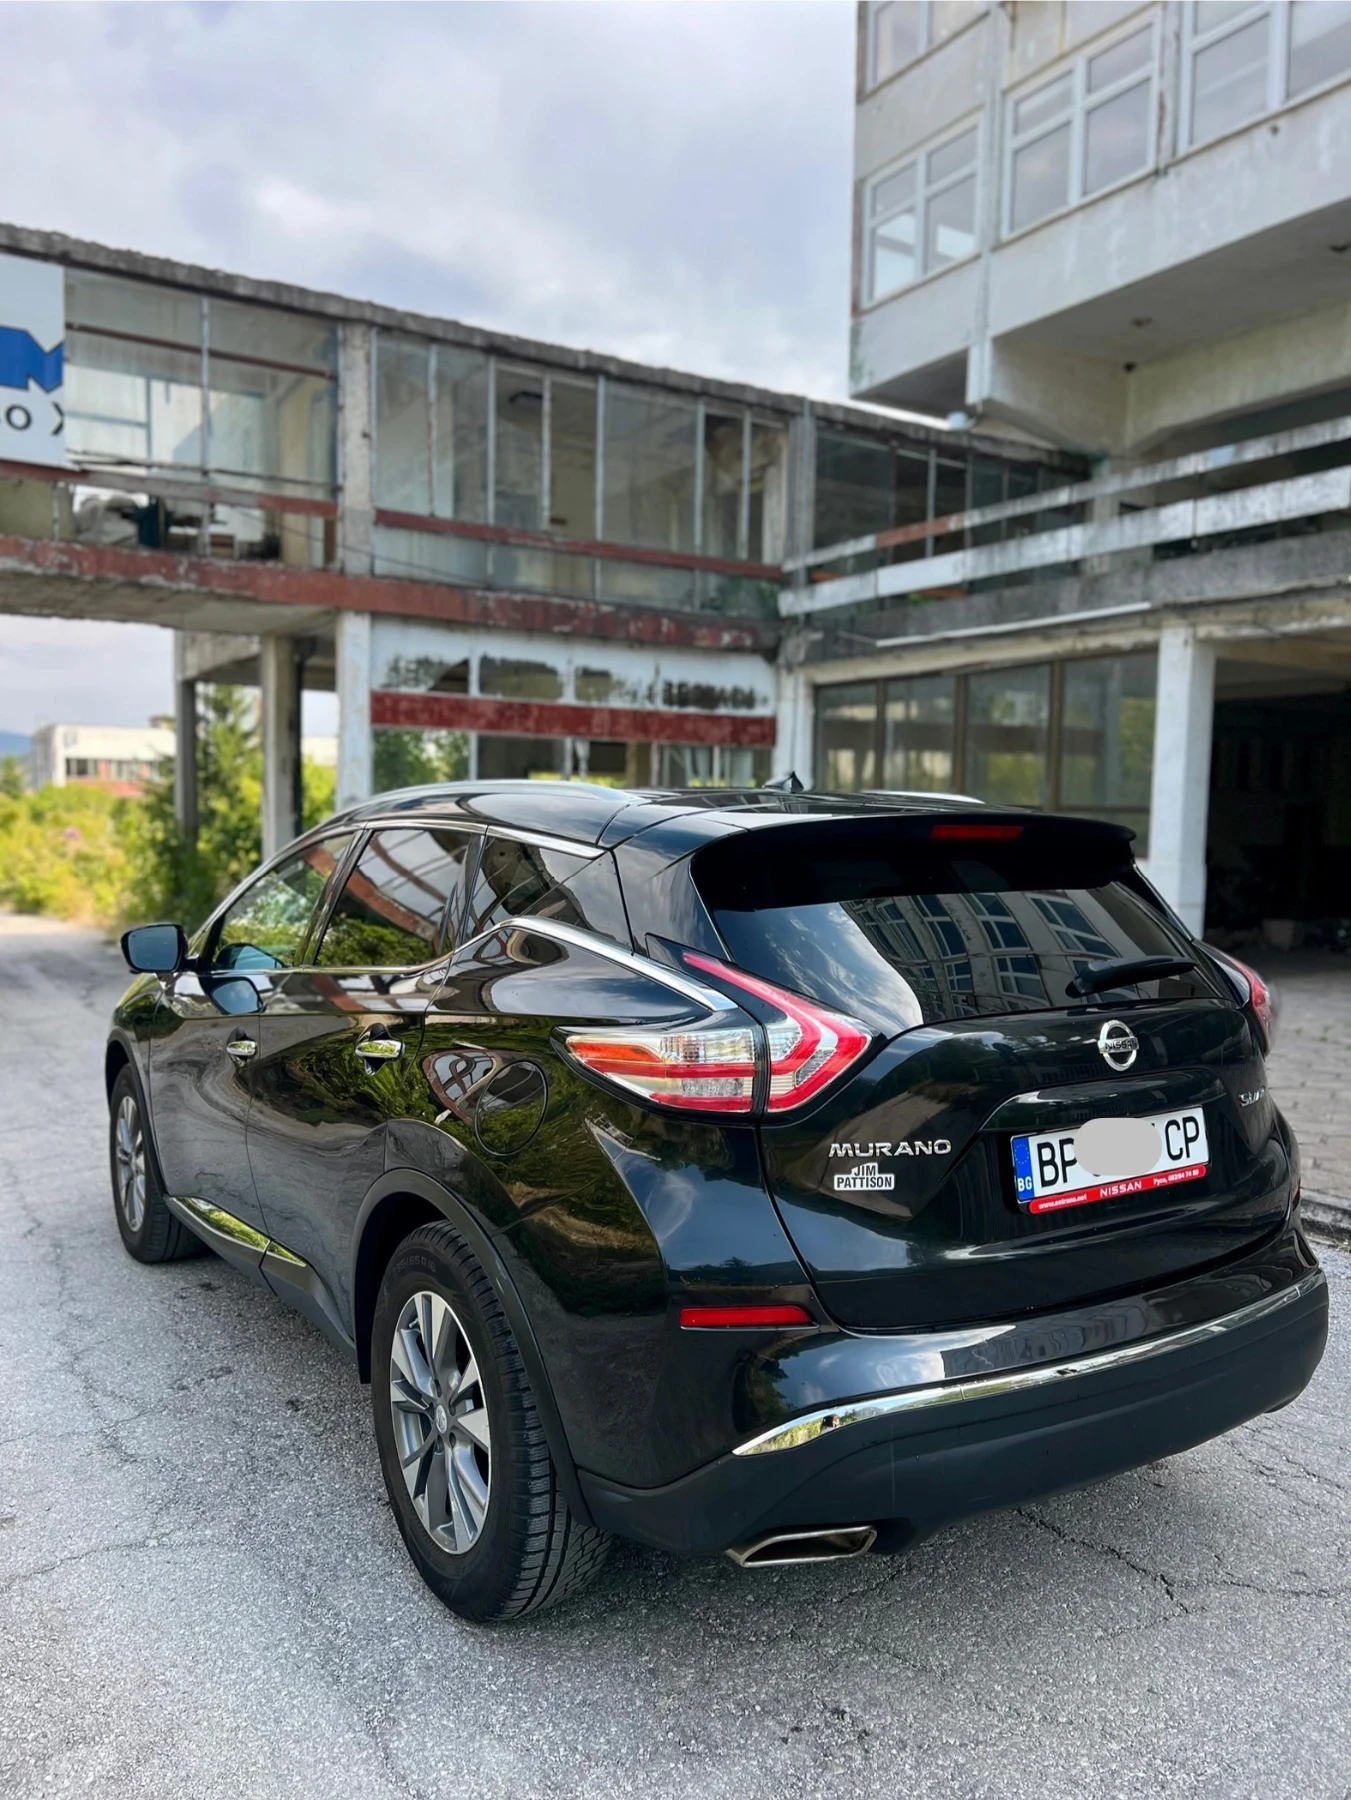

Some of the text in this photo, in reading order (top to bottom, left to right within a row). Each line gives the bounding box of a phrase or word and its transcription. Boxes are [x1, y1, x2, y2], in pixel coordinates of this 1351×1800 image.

[1104, 1038, 1137, 1051] NISSAN
[1164, 1115, 1200, 1161] CP
[828, 1139, 952, 1158] MURANO
[854, 1165, 877, 1177] JIM
[836, 1176, 893, 1189] PATTISON
[1017, 1177, 1033, 1192] BG
[1099, 1181, 1142, 1198] NISSAN
